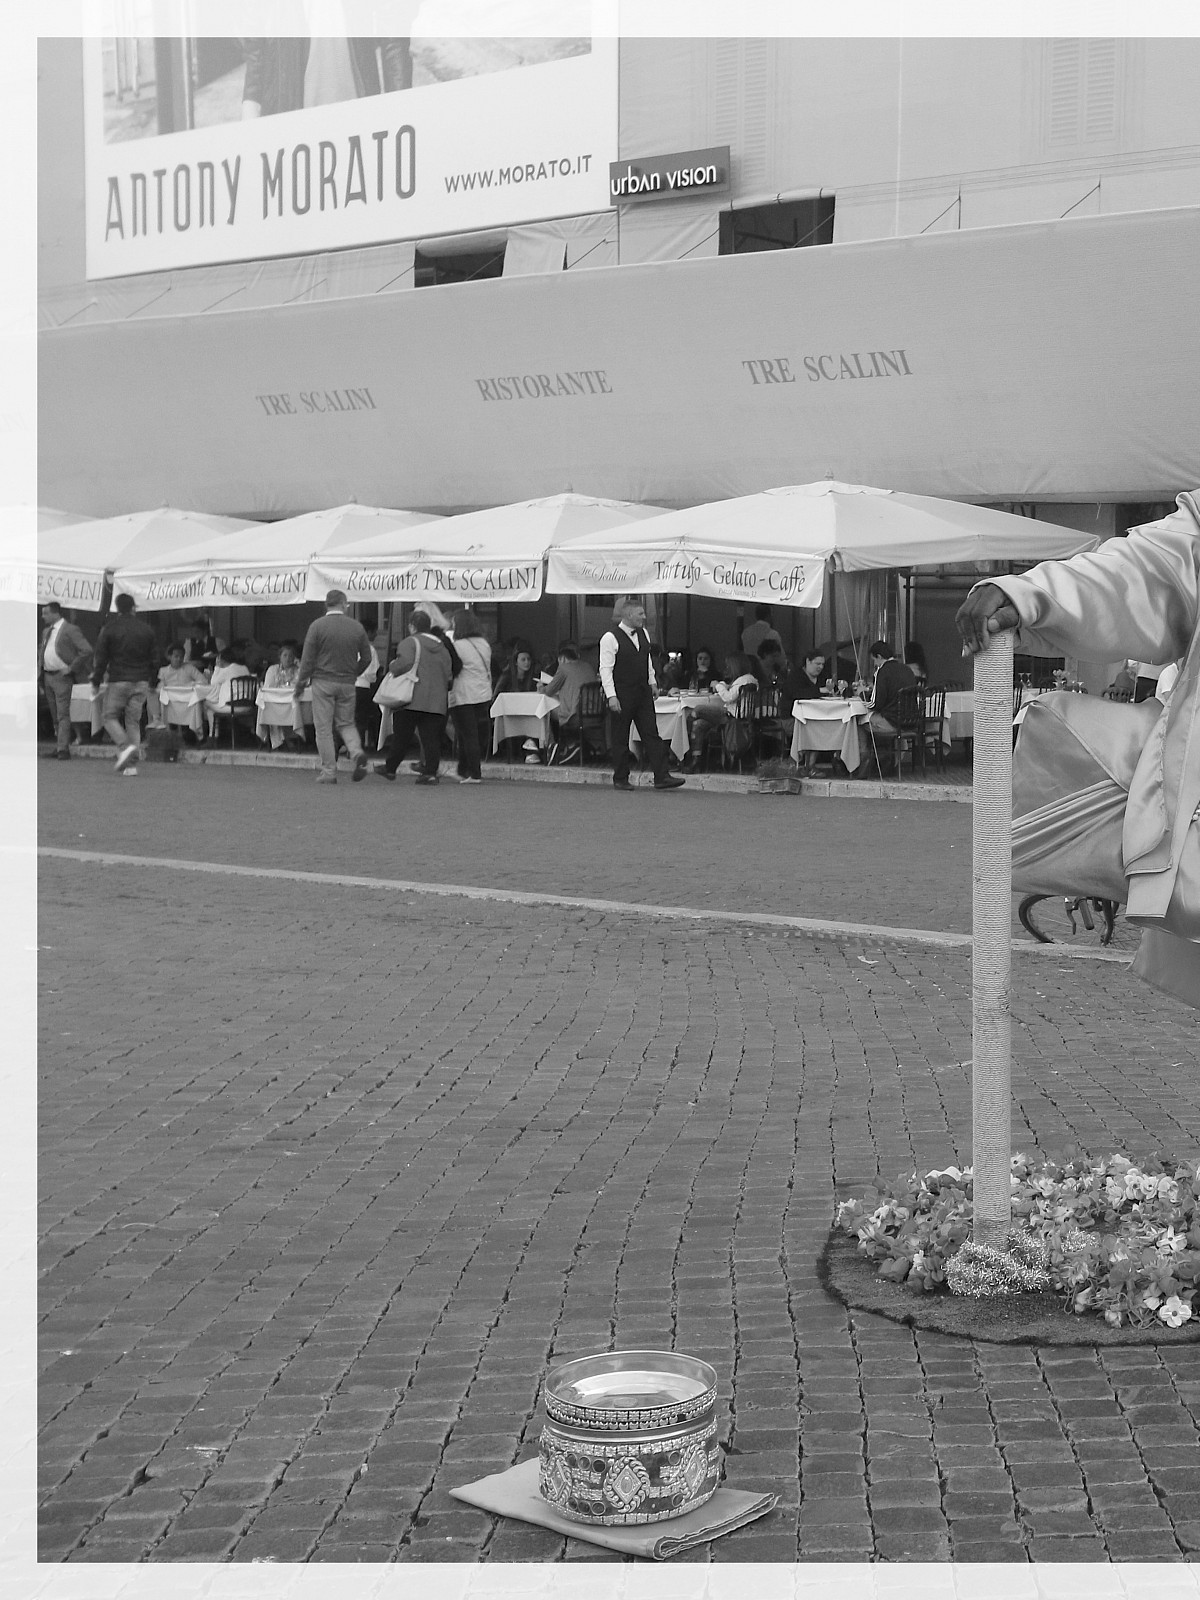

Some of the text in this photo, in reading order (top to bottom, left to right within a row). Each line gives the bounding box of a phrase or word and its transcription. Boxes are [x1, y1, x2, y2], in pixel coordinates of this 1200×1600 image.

[260, 123, 417, 220] MORATO
[444, 154, 593, 193] WWW.MORATO.IT
[666, 165, 717, 188] vision
[742, 349, 914, 386] TRE SCALINI
[475, 370, 614, 402] RISTORANTE
[255, 387, 377, 417] TRE SCALINI
[45, 575, 102, 601] SCALINI
[147, 578, 207, 600] Ristorante
[210, 576, 241, 596] TRE
[242, 572, 307, 596] SCALINI
[347, 567, 418, 591] Ristorante
[422, 568, 457, 591] TRE
[460, 567, 538, 591] SCALINI
[653, 557, 701, 589] Tartufo
[713, 561, 756, 588] Gelato
[768, 565, 806, 601] Caffè
